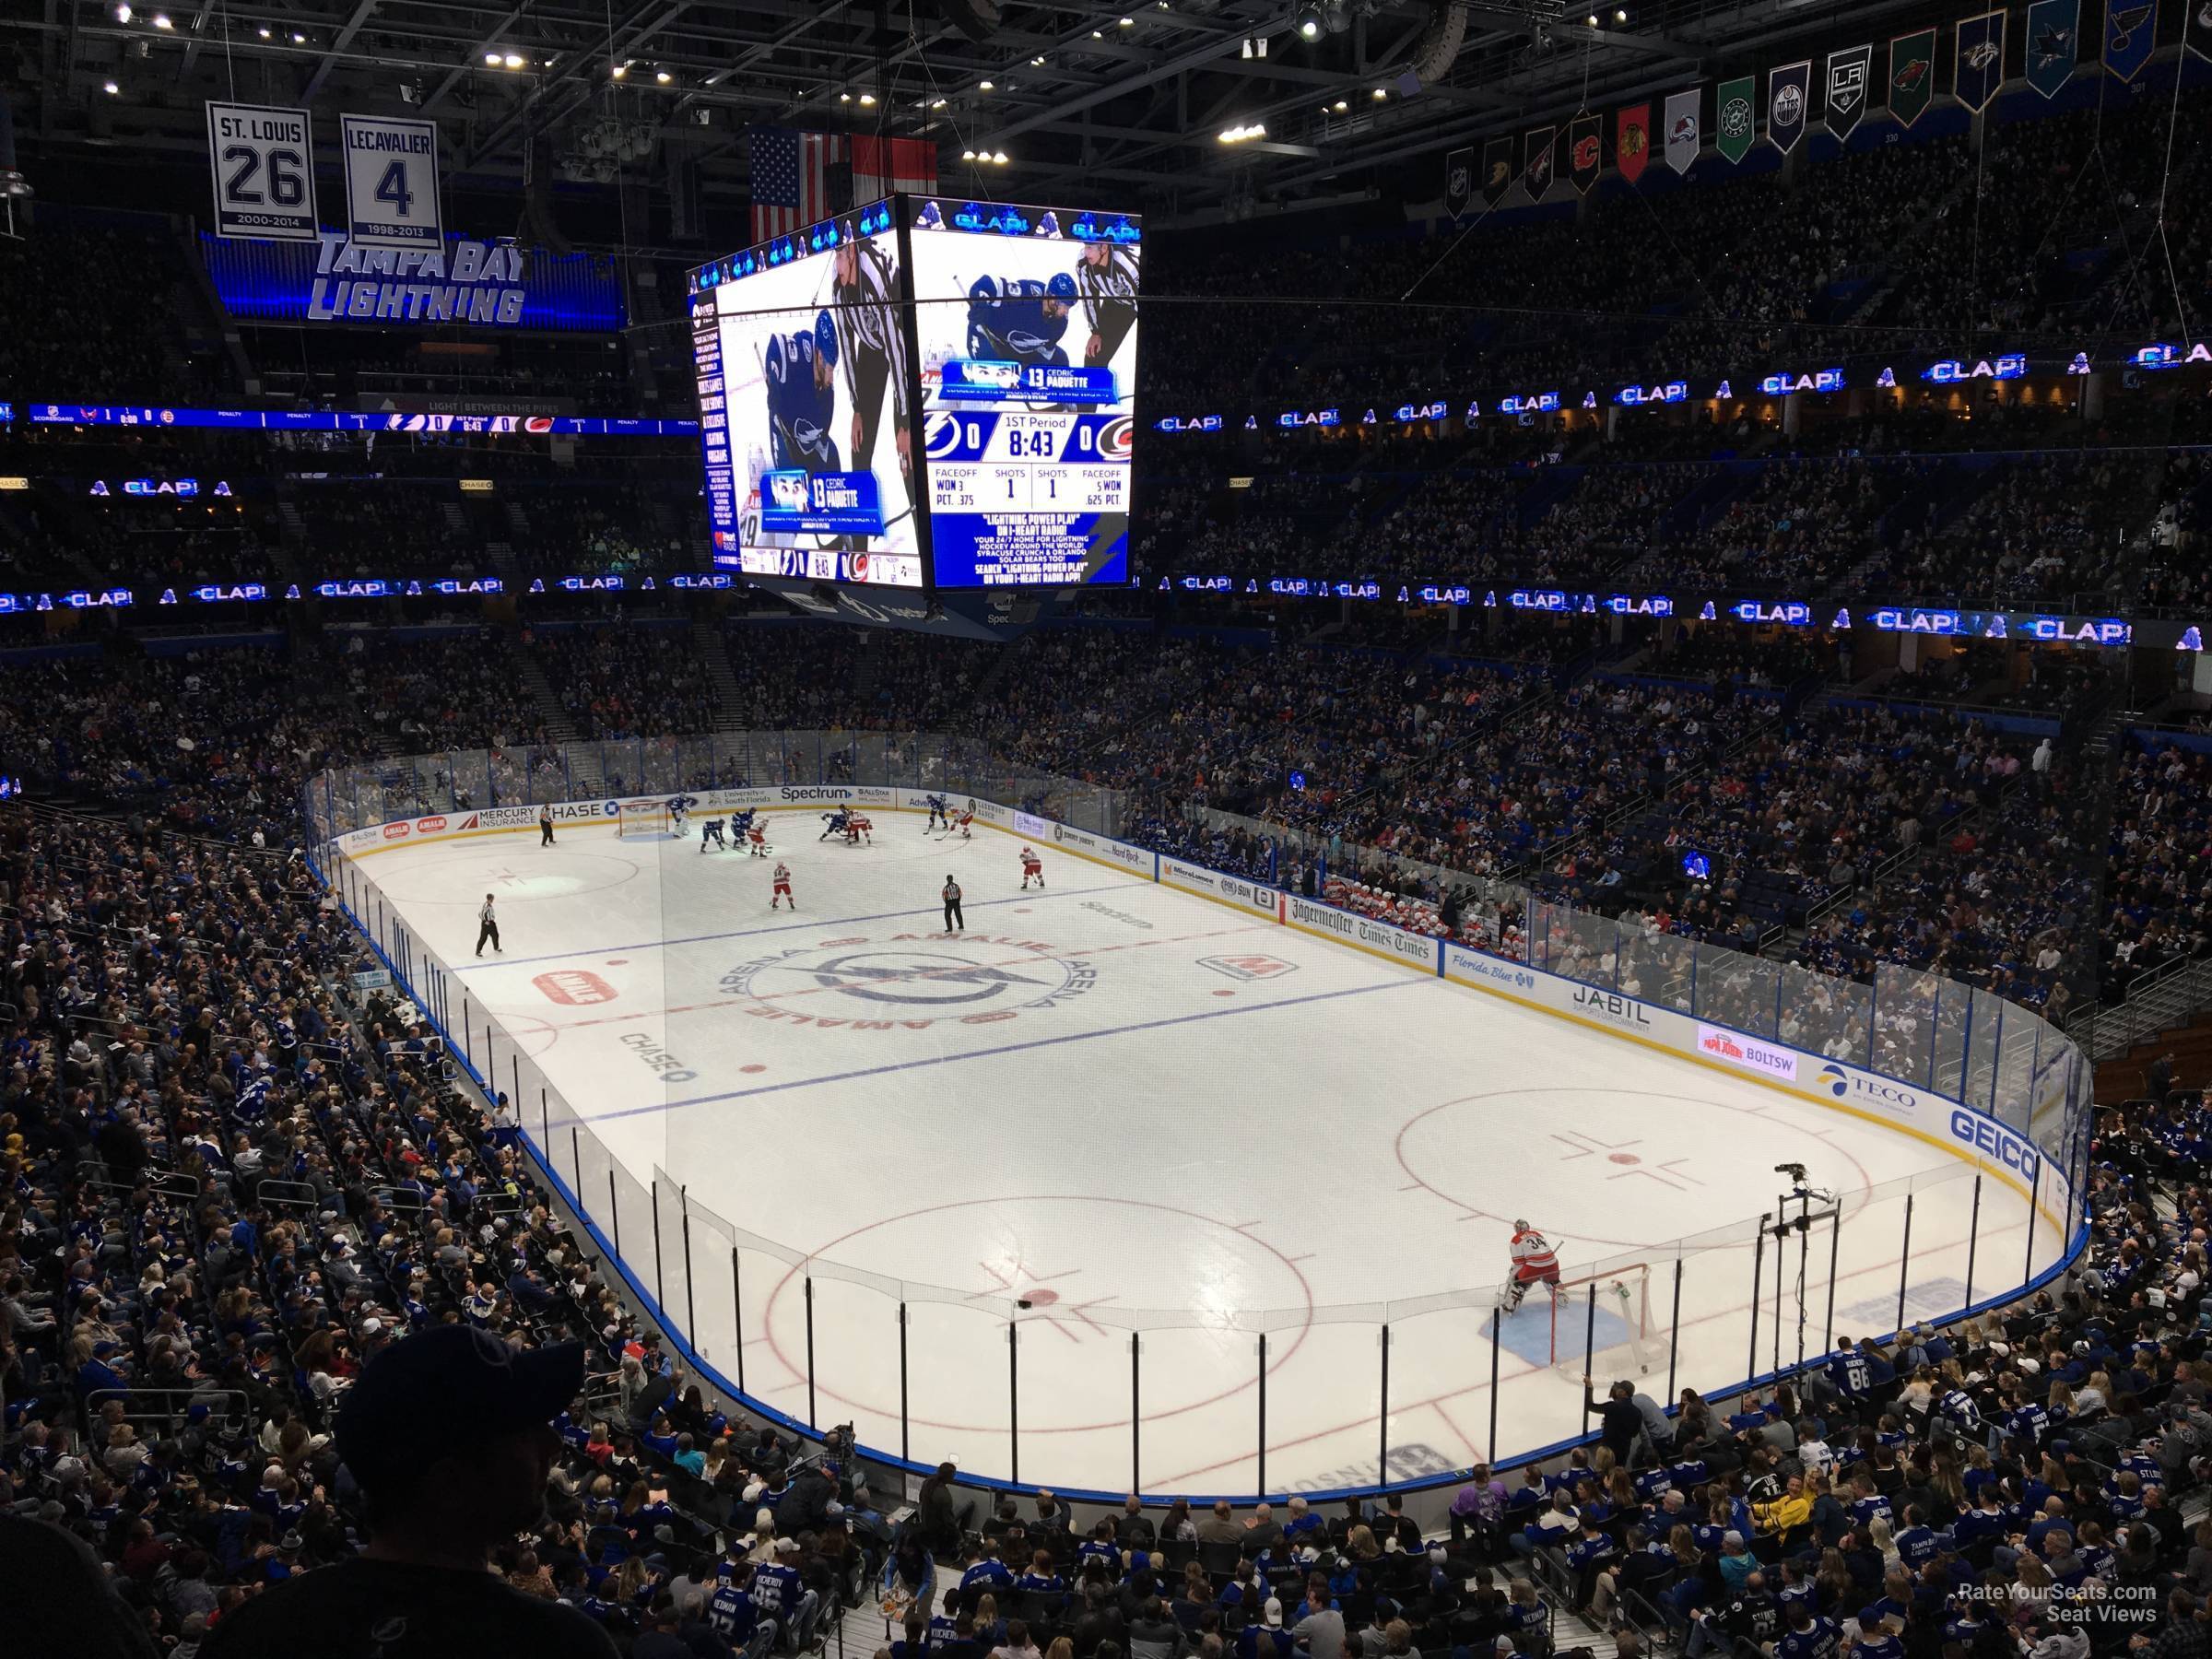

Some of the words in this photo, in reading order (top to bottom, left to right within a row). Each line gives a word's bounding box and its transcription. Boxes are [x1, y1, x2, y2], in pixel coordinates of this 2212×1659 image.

[221, 118, 247, 139] ST.
[252, 120, 301, 143] LOUIS
[348, 129, 430, 155] LECAVALIER
[222, 145, 305, 206] 26
[373, 159, 414, 218] 4
[237, 214, 300, 228] 2000-2014
[367, 224, 425, 238] 1998-2013
[316, 233, 445, 277] TAMPA
[451, 241, 524, 281] BAY
[307, 279, 525, 323] LIGHTNING
[1933, 357, 2026, 381] CLAP!
[1029, 369, 1044, 387] 13
[1762, 372, 1841, 394] CLAP!
[1621, 382, 1688, 403] CLAP!
[429, 402, 457, 412] LIGHT
[465, 403, 511, 413] BETWEEN
[512, 404, 530, 413] THE
[532, 405, 559, 414] PIPES
[1501, 394, 1559, 411] CLAP!
[1280, 409, 1339, 426] CLAP!
[1398, 404, 1447, 420] CLAP!
[434, 416, 442, 429] 0
[464, 421, 482, 432] 8:43
[1006, 417, 1027, 427] 1ST
[1030, 417, 1066, 428] Period
[1160, 417, 1222, 431] CLAP!
[967, 423, 980, 450] 0
[1009, 430, 1053, 457] 8:43
[1080, 425, 1092, 451] 0
[935, 468, 978, 477] FACEOFF
[995, 469, 1026, 477] SHOTS
[1038, 469, 1067, 478] SHOTS
[1082, 470, 1121, 478] FACEOFF
[0, 479, 20, 488] HASE
[124, 481, 199, 495] CLAP!
[826, 478, 846, 489] CEDRIC
[936, 480, 956, 491] WON
[959, 481, 963, 491] 3
[1103, 480, 1122, 491] WON
[813, 478, 825, 507] 13
[957, 495, 974, 506] .375
[1029, 514, 1055, 525] POWER
[996, 525, 1008, 535] ON
[1009, 525, 1040, 535] I-HEART
[1041, 524, 1067, 535] RADIO!
[975, 564, 1002, 574] SEARCH
[1042, 563, 1067, 572] POWER
[441, 580, 503, 593] CLAP!
[565, 576, 624, 589] CLAP!
[674, 576, 732, 588] CLAP!
[983, 574, 994, 584] ON
[994, 573, 1013, 583] YOUR
[1015, 573, 1041, 583] I-HEART
[1042, 572, 1064, 582] RADIO
[1065, 572, 1081, 582] APP!
[1185, 577, 1232, 590] CLAP!
[200, 585, 265, 598] CLAP!
[321, 582, 386, 595] CLAP!
[1339, 584, 1381, 598] CLAP!
[1423, 587, 1470, 604] CLAP!
[71, 592, 134, 606] CLAP!
[1512, 592, 1566, 609] CLAP!
[1613, 597, 1674, 616] CLAP!
[1739, 603, 1810, 623] CLAP!
[1877, 610, 1959, 633] CLAP!
[2036, 619, 2132, 645] CLAP!
[724, 790, 759, 798] University
[781, 787, 848, 802] Spectrum
[479, 807, 535, 819] MERCURY
[553, 804, 601, 818] HASE
[479, 816, 536, 828] INSURANCE
[1112, 845, 1125, 859] Hard
[1125, 849, 1139, 865] Rock
[892, 933, 1055, 951] AMALIE
[1359, 922, 1392, 946] Times
[1394, 933, 1429, 959] Times
[720, 947, 814, 994] ARENA
[1453, 954, 1489, 975] Florida
[1490, 964, 1512, 982] Blue
[1024, 960, 1097, 1009] ARENA
[1573, 986, 1651, 1024] JABIL
[744, 1006, 931, 1030] AMALIE
[619, 1033, 683, 1072] CHASE
[1747, 1047, 1793, 1071] BOLTSW
[1851, 1076, 1916, 1108] TECO
[1950, 1110, 2036, 1183] GEICO
[1847, 1368, 1870, 1392] 86
